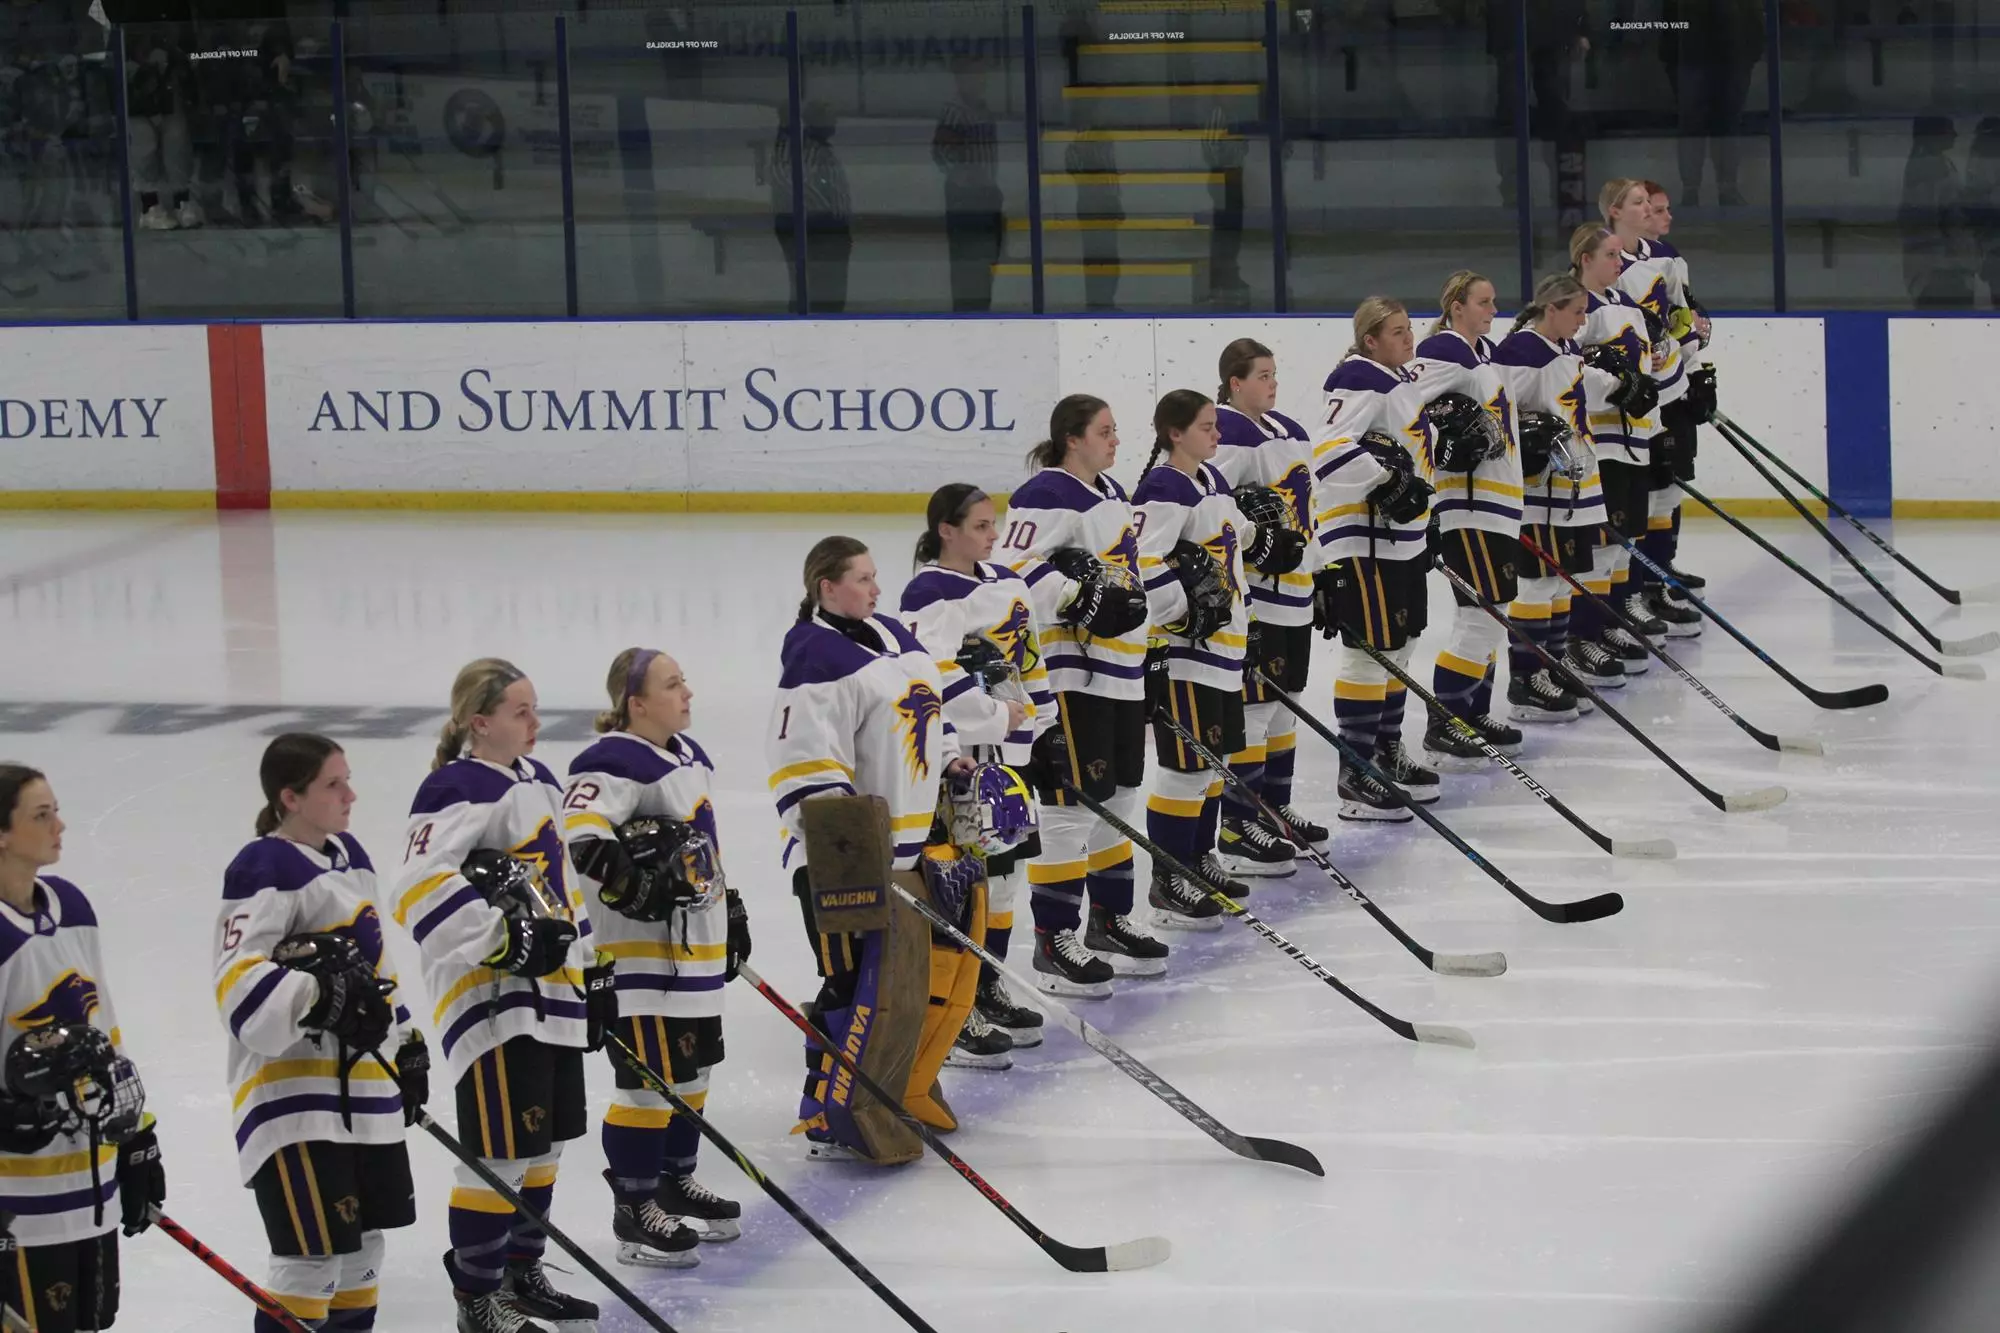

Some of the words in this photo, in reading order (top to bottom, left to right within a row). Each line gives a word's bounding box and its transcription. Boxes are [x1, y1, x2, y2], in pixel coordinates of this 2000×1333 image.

[308, 390, 441, 432] AND
[458, 369, 726, 432] SUMMIT
[742, 367, 1015, 432] SCHOOL
[1326, 398, 1343, 425] 7
[1002, 520, 1037, 550] 10
[778, 706, 791, 740] 1
[1481, 744, 1551, 800] BAUER
[563, 782, 600, 810] 12
[404, 824, 434, 863] 14
[821, 890, 878, 908] VAUGHN
[222, 913, 250, 952] 15
[947, 1154, 1011, 1210] VAPOR
